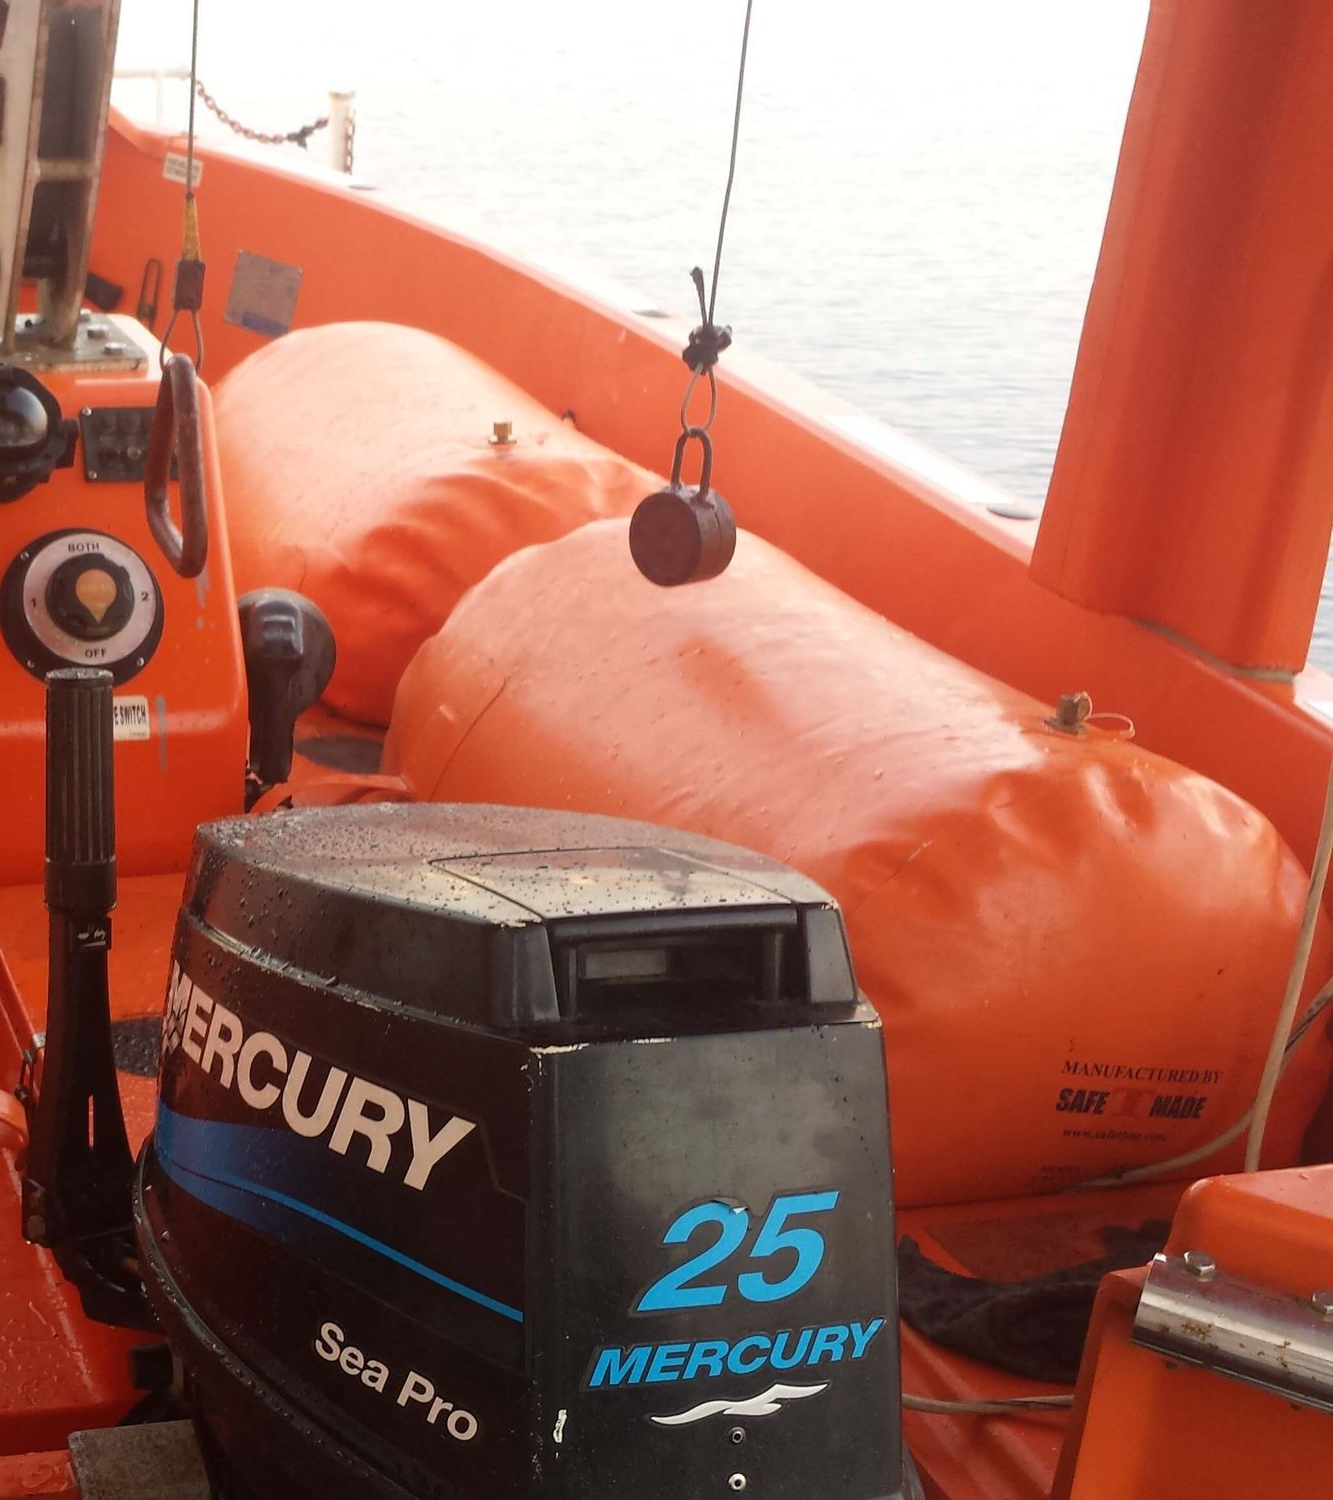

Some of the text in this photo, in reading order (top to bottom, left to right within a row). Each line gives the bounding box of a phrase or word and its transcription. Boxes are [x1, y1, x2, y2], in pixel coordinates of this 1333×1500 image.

[67, 541, 100, 553] BOTH
[31, 597, 37, 608] 1
[141, 591, 149, 602] 2
[84, 647, 107, 658] OFF
[119, 704, 147, 725] SWITCH
[163, 960, 477, 1191] MERCURY
[1062, 1060, 1223, 1084] MANUFACTURED BY
[1055, 1088, 1111, 1115] SAFE
[1148, 1095, 1207, 1119] MADE
[637, 1191, 839, 1312] 25
[588, 1318, 886, 1388] MERCURY
[315, 1322, 478, 1441] Sea Pro
